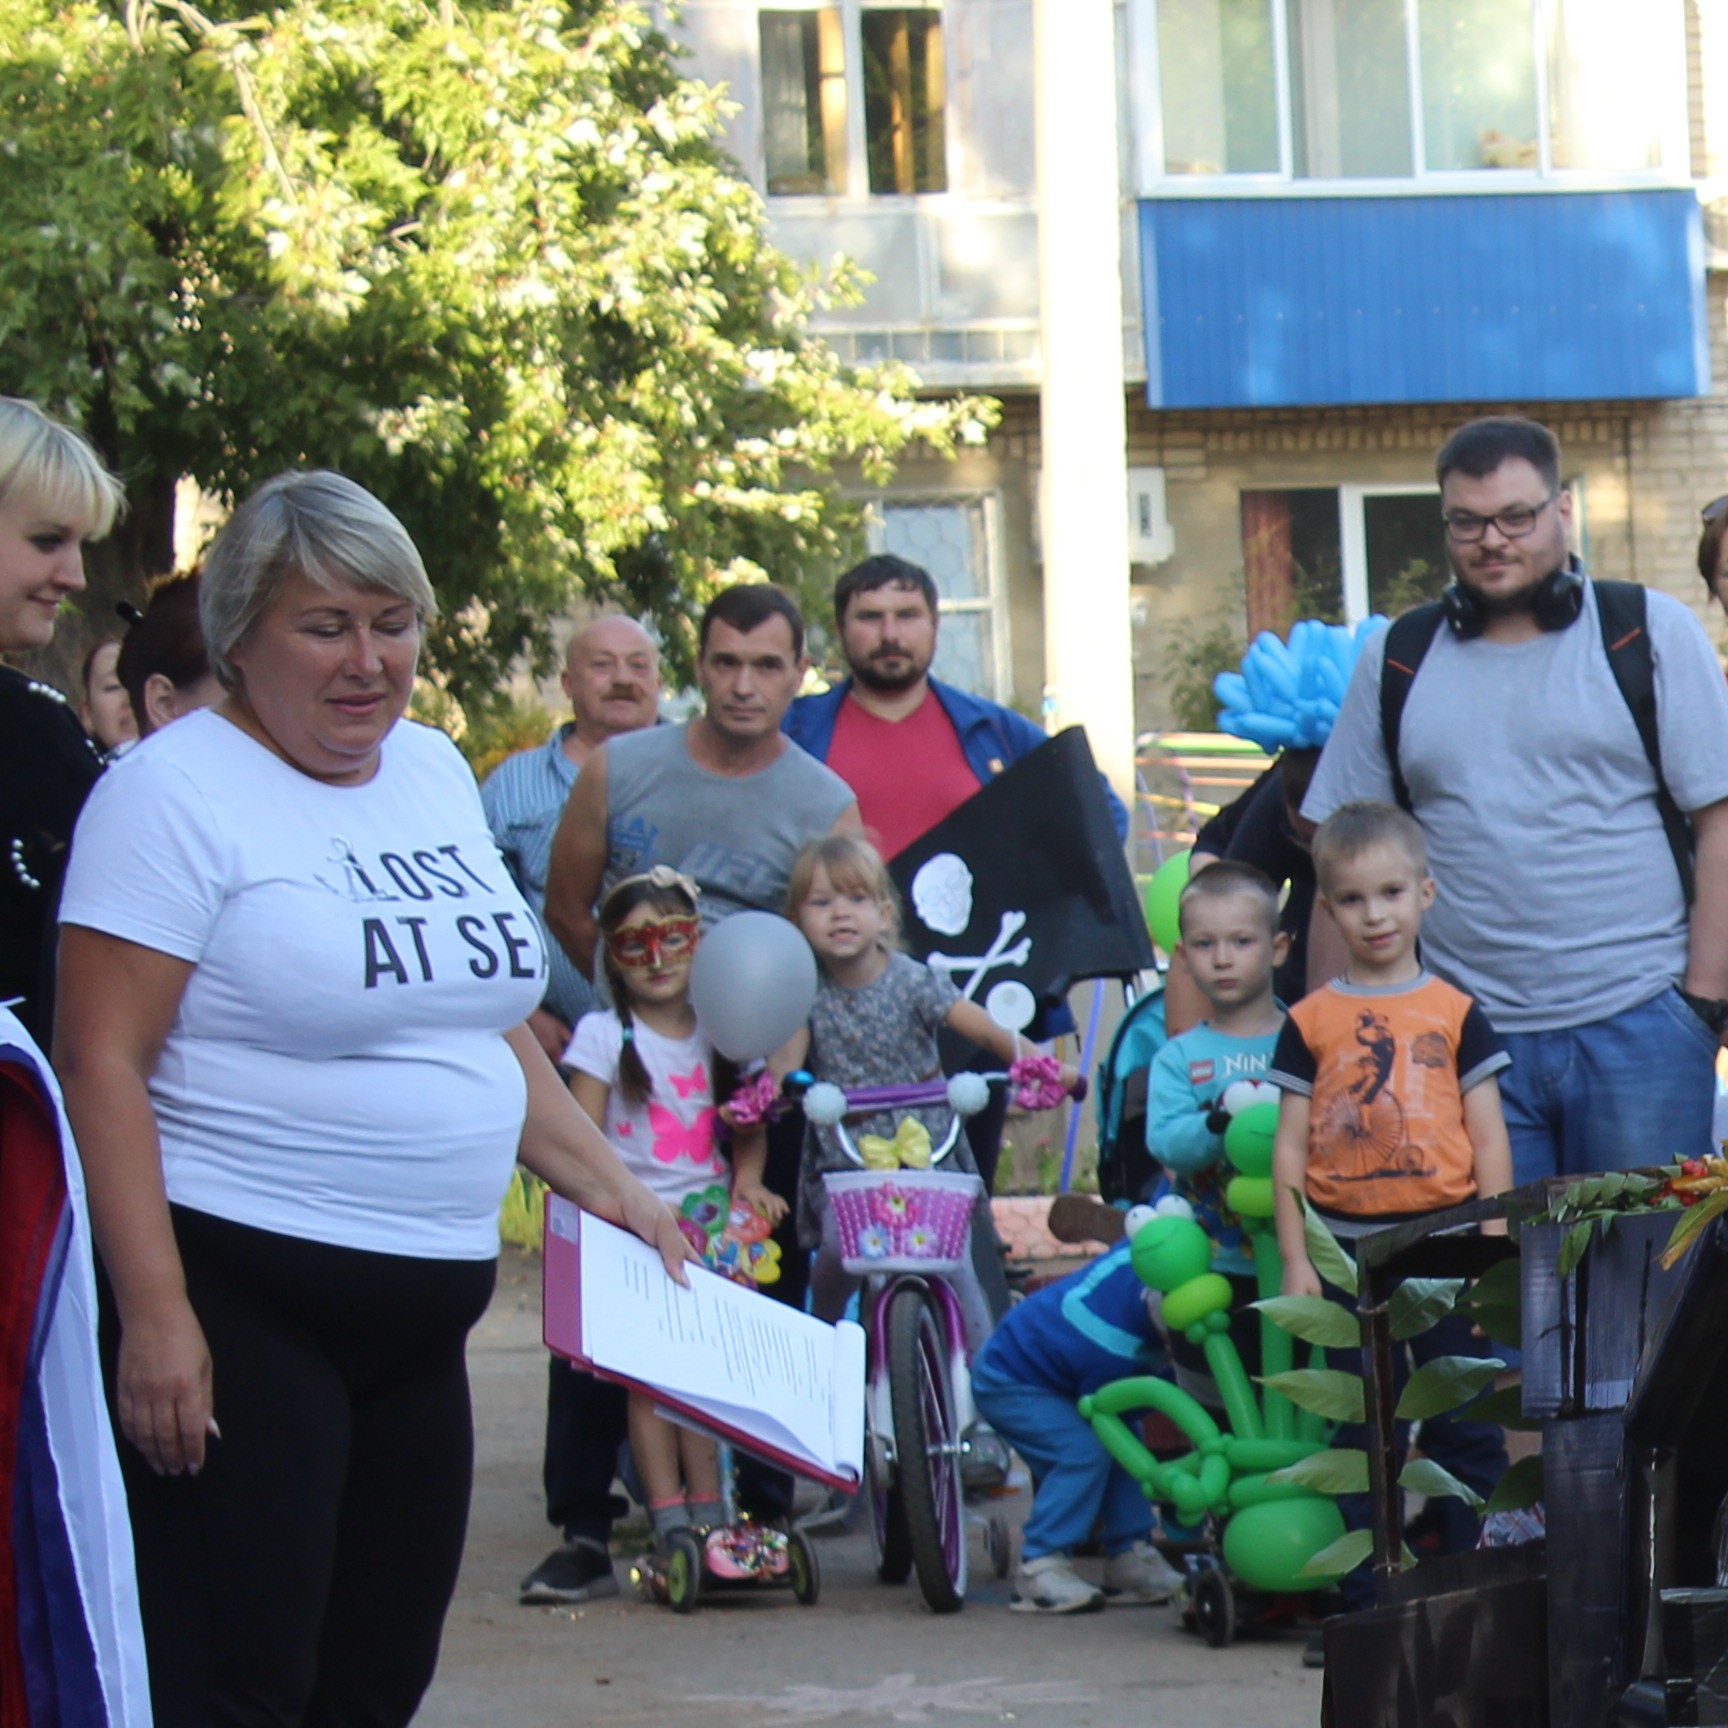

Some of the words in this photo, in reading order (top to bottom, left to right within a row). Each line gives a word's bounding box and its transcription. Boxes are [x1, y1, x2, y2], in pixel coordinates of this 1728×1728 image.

[346, 844, 497, 902] LOST
[361, 916, 434, 989] AT
[455, 910, 545, 980] SE
